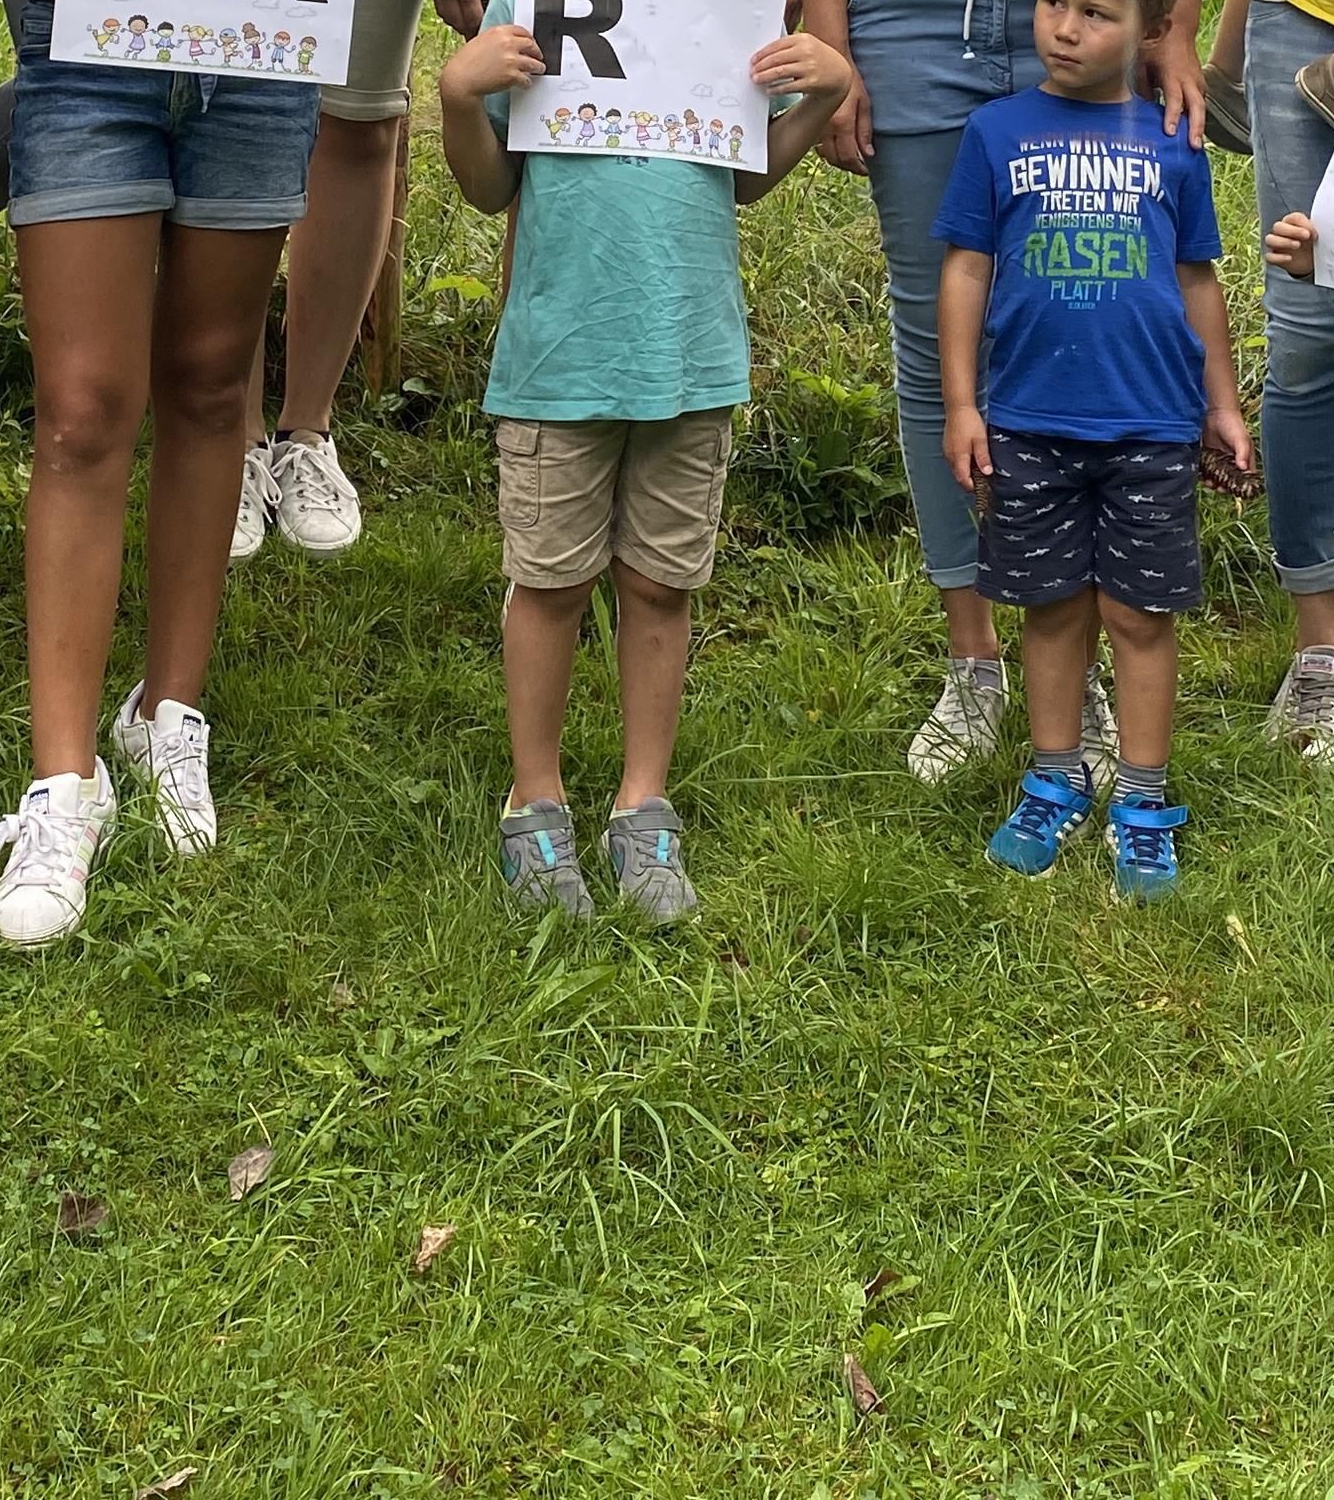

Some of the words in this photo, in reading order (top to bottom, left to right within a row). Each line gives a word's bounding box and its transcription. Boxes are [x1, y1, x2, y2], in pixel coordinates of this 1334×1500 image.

[1008, 153, 1165, 202] GEWINNEN,
[1040, 190, 1106, 212] TRETEN
[1112, 191, 1140, 215] WIR
[1119, 214, 1142, 233] DEN
[1023, 231, 1147, 280] RASEN
